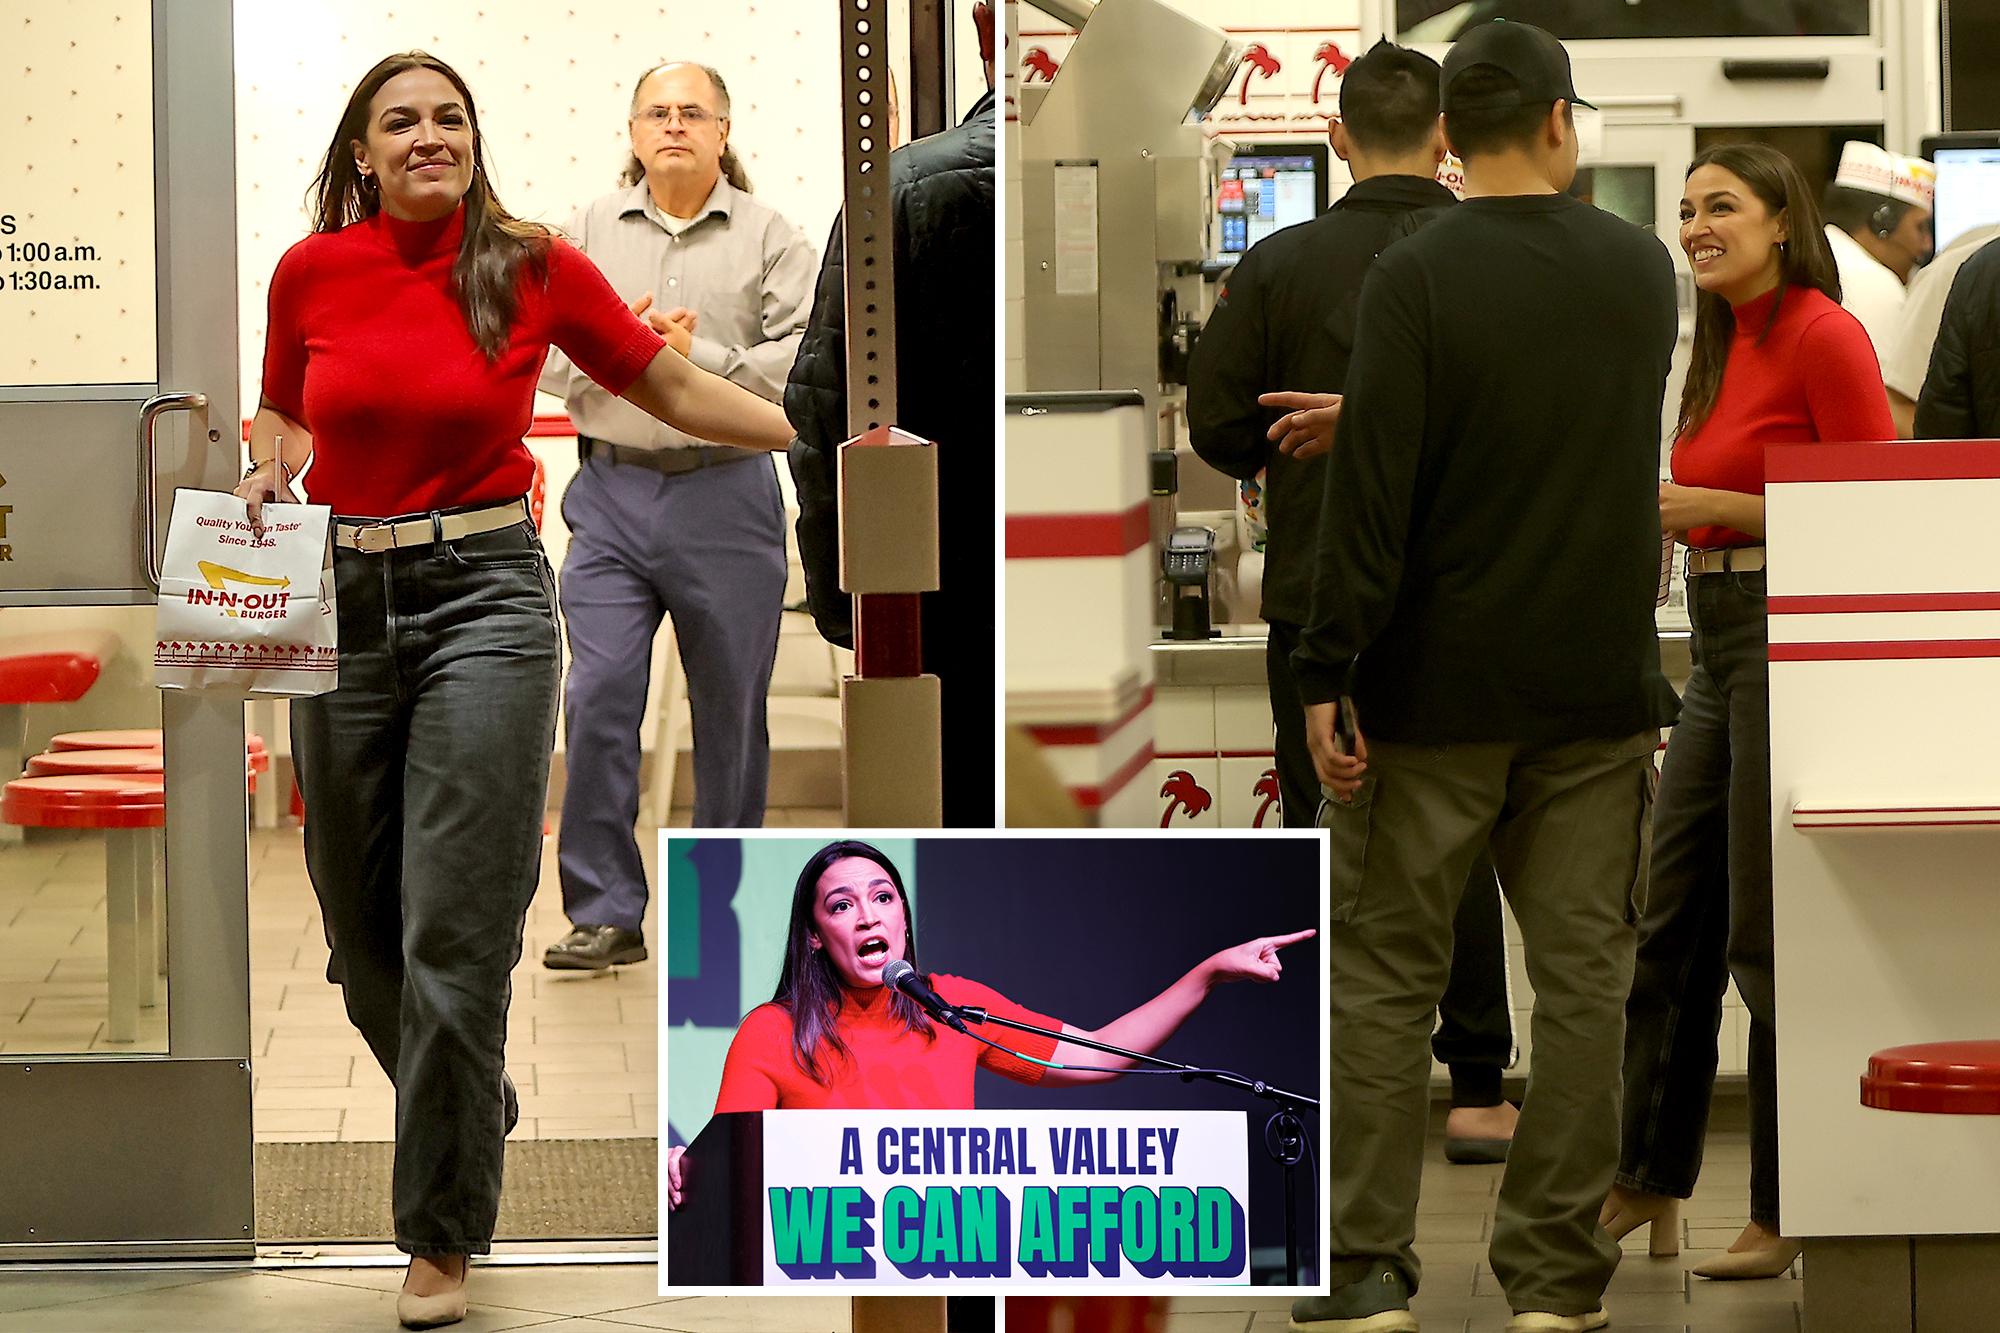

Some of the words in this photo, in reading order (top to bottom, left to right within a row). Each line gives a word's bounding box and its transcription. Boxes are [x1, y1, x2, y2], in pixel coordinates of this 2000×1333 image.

[6, 242, 50, 262] 1:00
[54, 245, 102, 262] a.m.
[9, 271, 52, 291] 1:30
[54, 273, 101, 290] a.m.
[196, 516, 233, 530] Quality
[235, 521, 252, 532] You
[218, 534, 247, 546] Since
[187, 588, 290, 610] IN-N-OUT
[240, 609, 287, 619] BURGER
[839, 1127, 863, 1175] A
[877, 1126, 1036, 1175] CENTRAL
[1049, 1127, 1180, 1175] VALLEY
[768, 1186, 876, 1280] WE
[882, 1185, 1012, 1279] CAN
[1017, 1185, 1246, 1278] AFFORD
